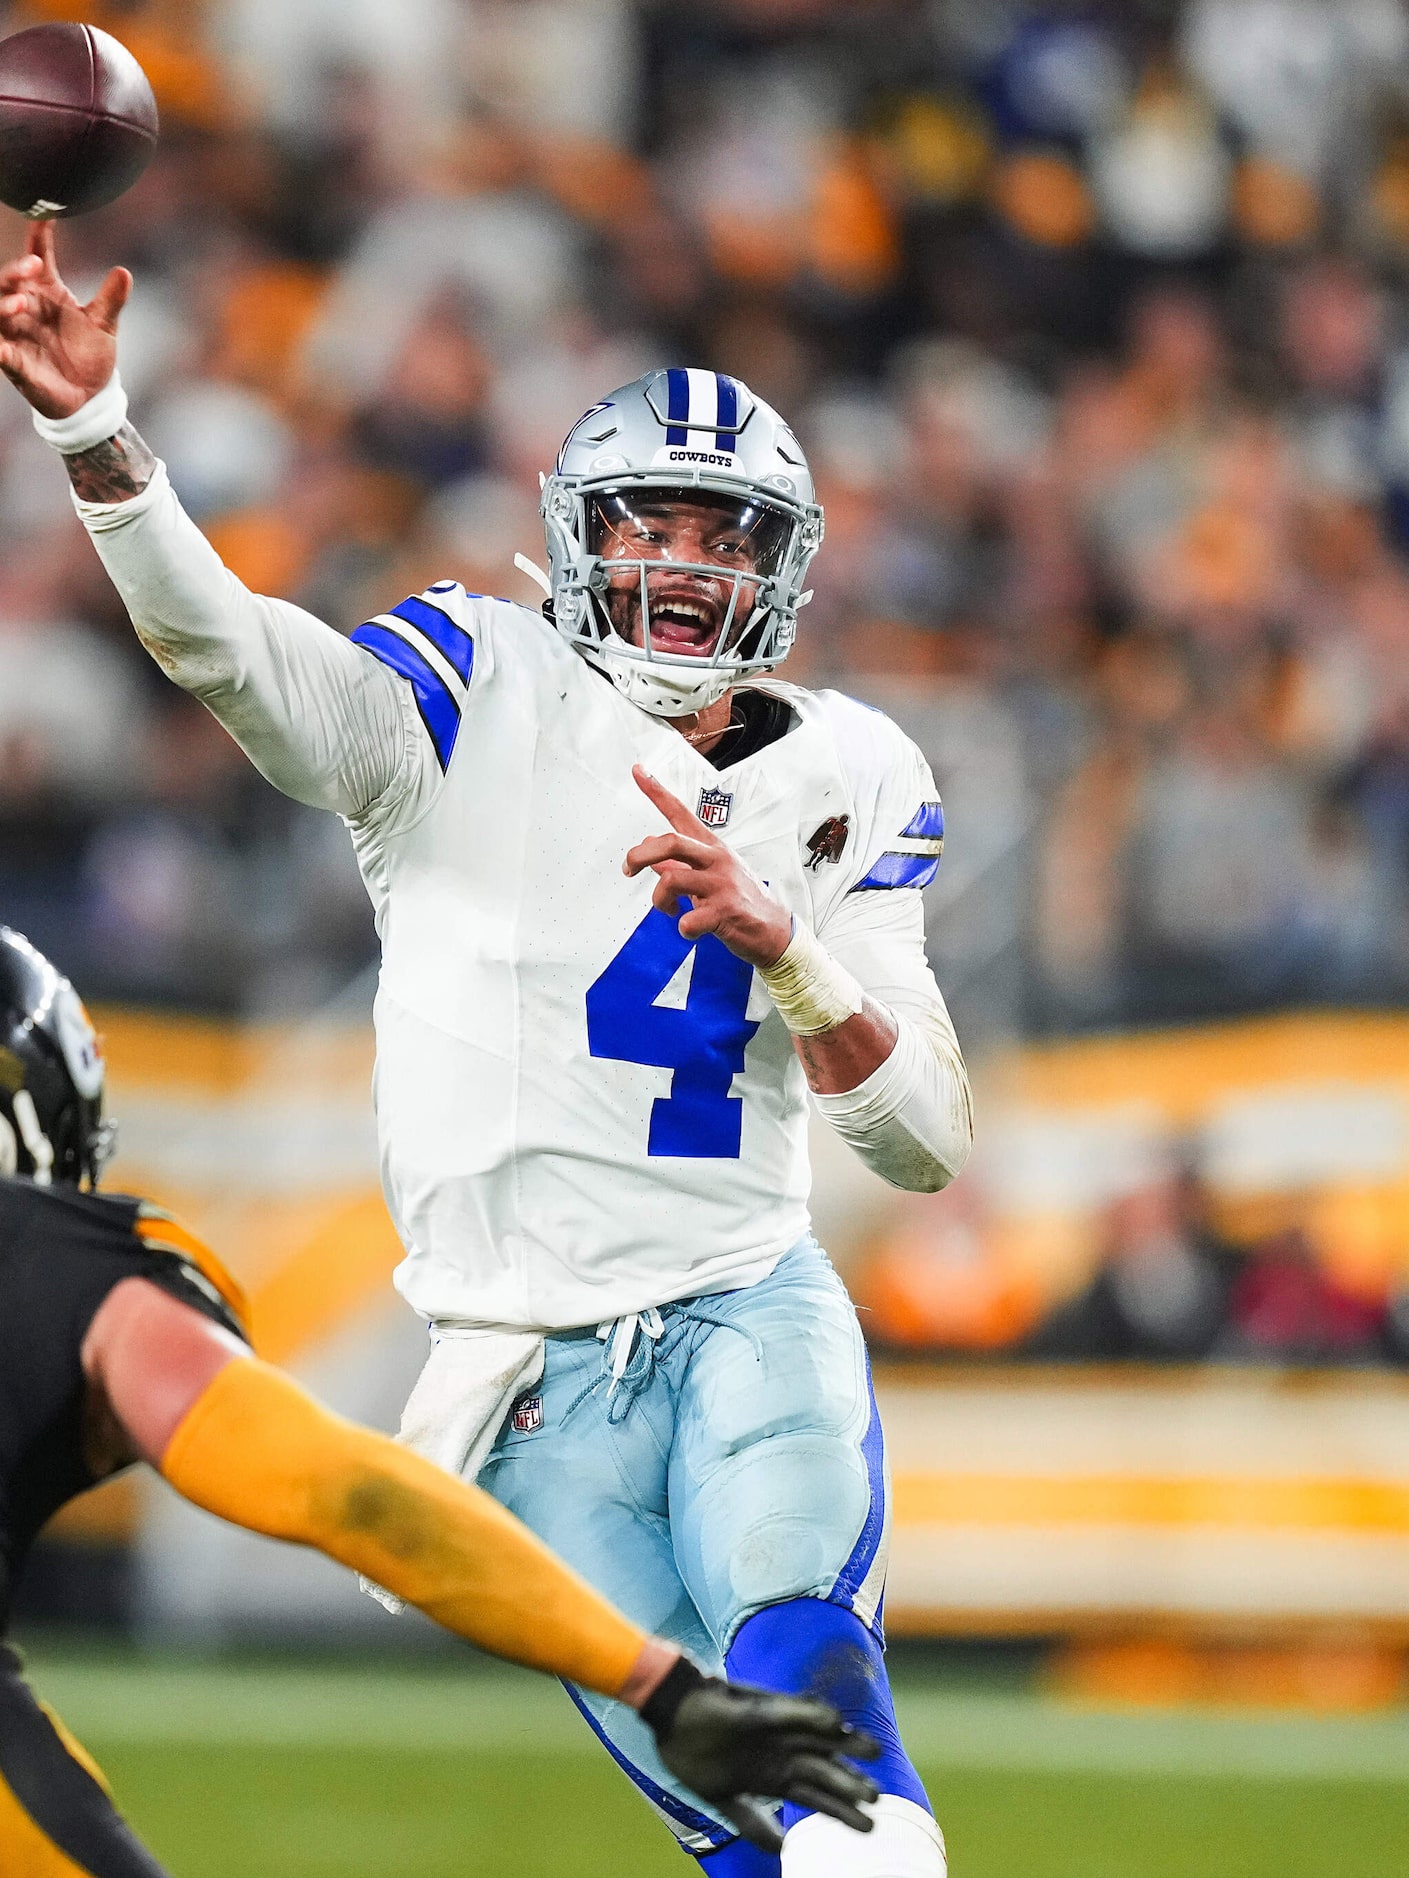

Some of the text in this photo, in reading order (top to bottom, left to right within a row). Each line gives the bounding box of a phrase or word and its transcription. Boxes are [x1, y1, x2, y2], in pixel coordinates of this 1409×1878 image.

[669, 450, 733, 468] COWBOYS
[700, 803, 726, 823] NFL
[586, 880, 770, 1160] 4
[514, 1410, 539, 1429] NFL
